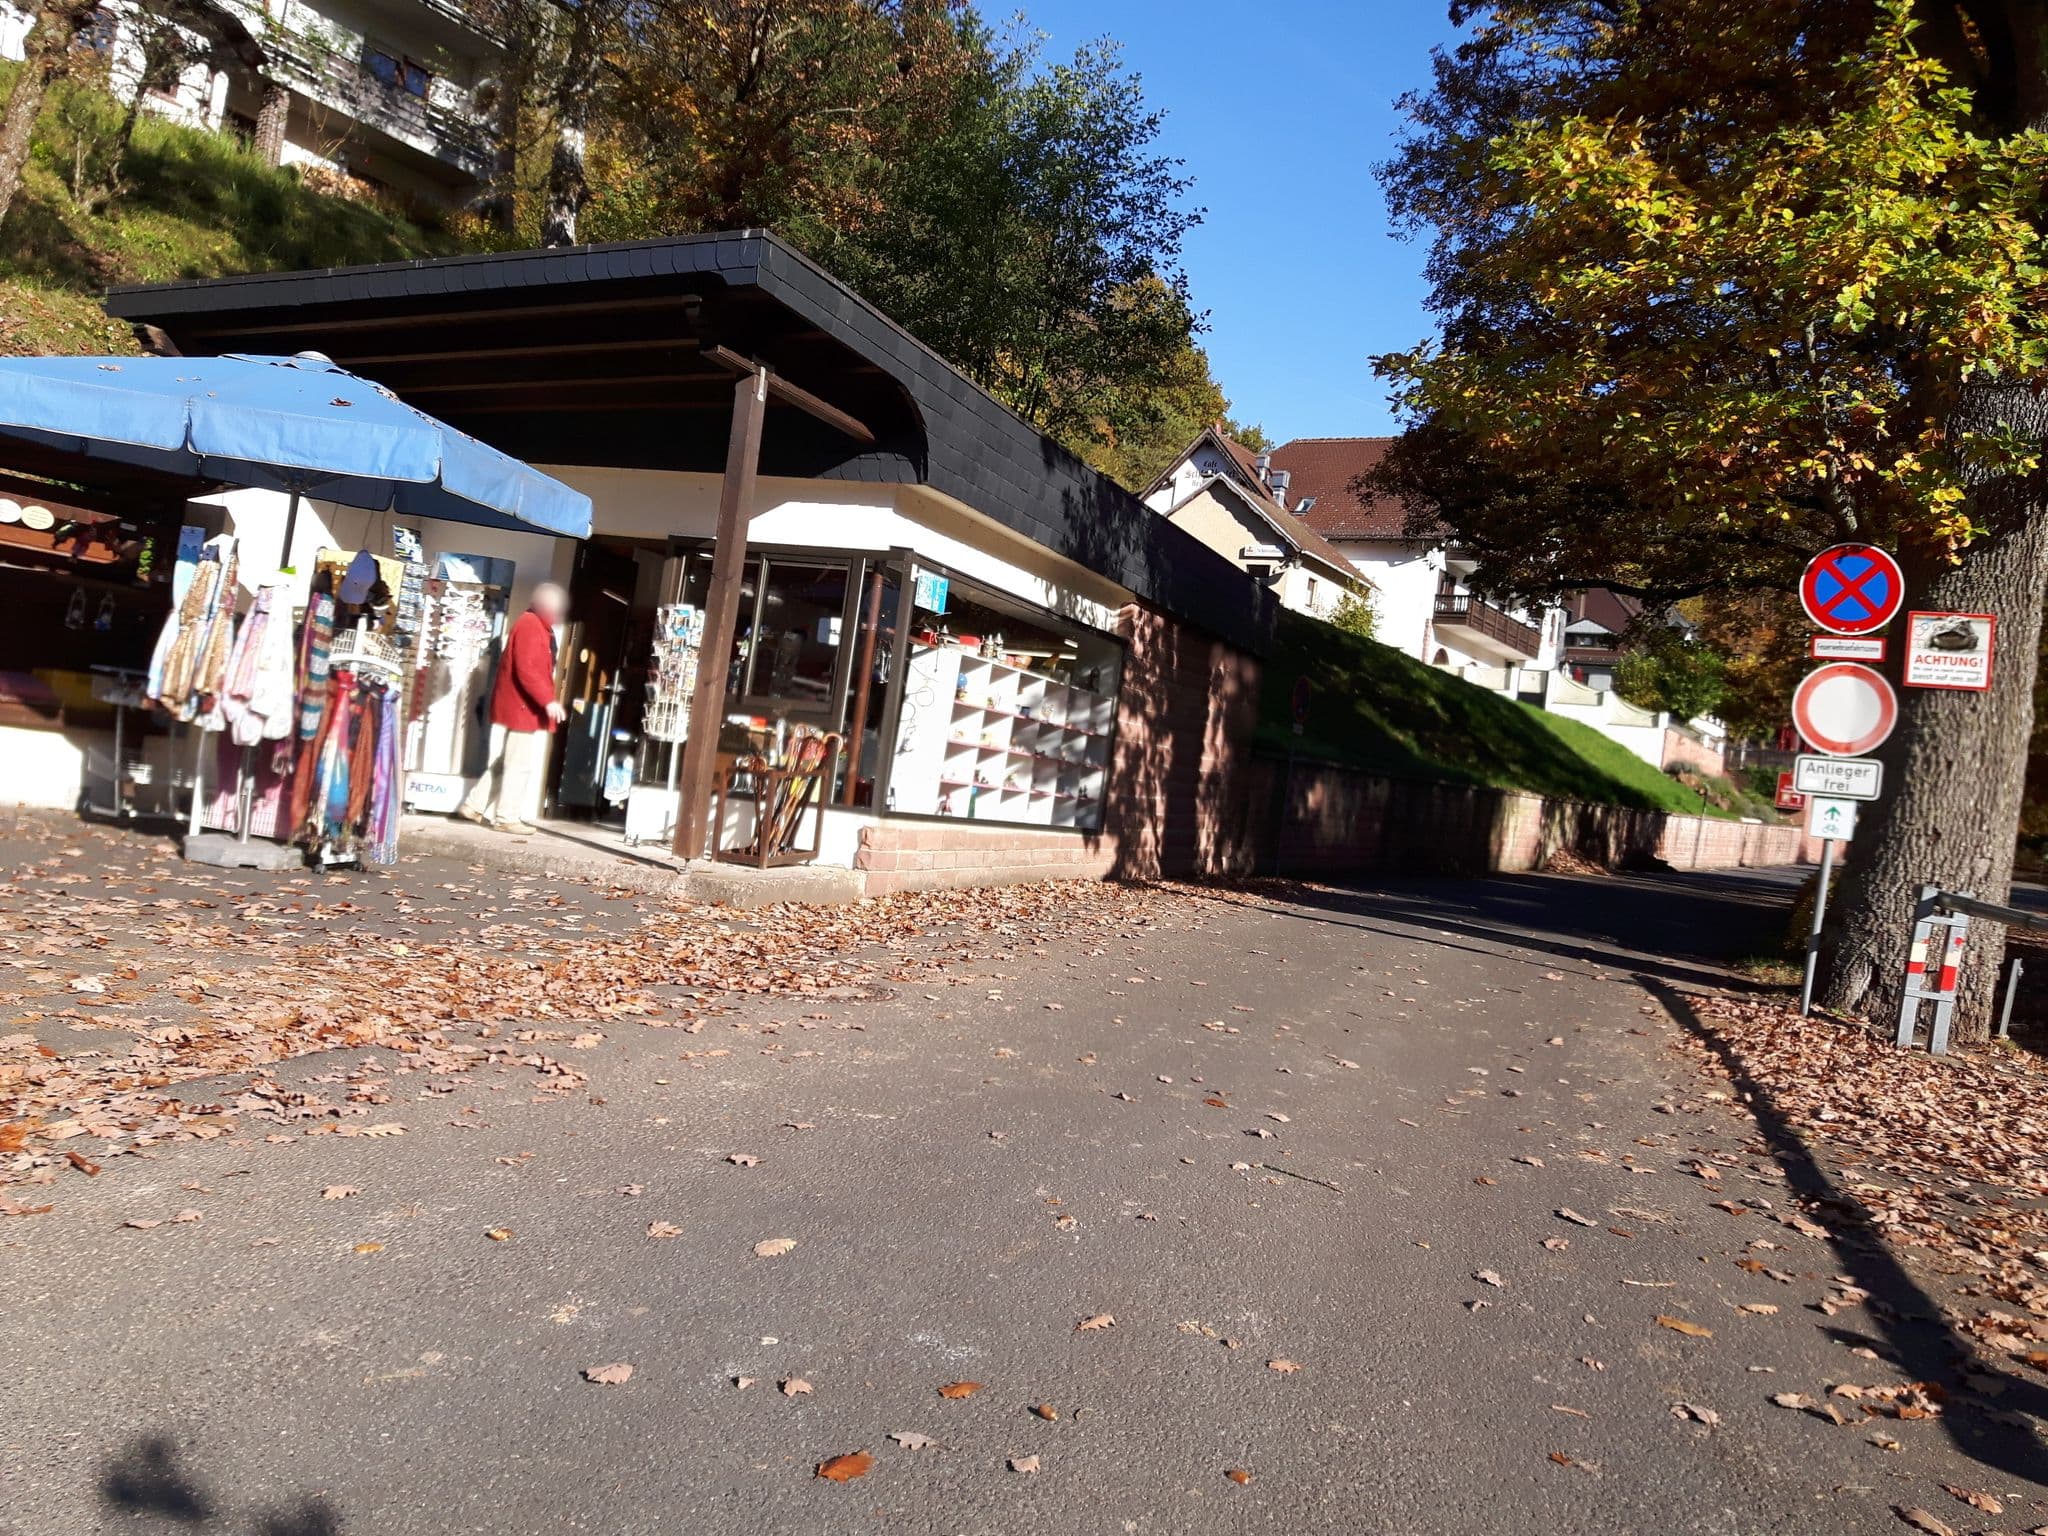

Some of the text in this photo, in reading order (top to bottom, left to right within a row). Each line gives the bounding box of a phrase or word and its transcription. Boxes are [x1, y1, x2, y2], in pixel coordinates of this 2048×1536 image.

[1914, 654, 1984, 668] ACHTUNG!
[1806, 761, 1871, 780] Anlieger
[1823, 779, 1850, 792] frei
